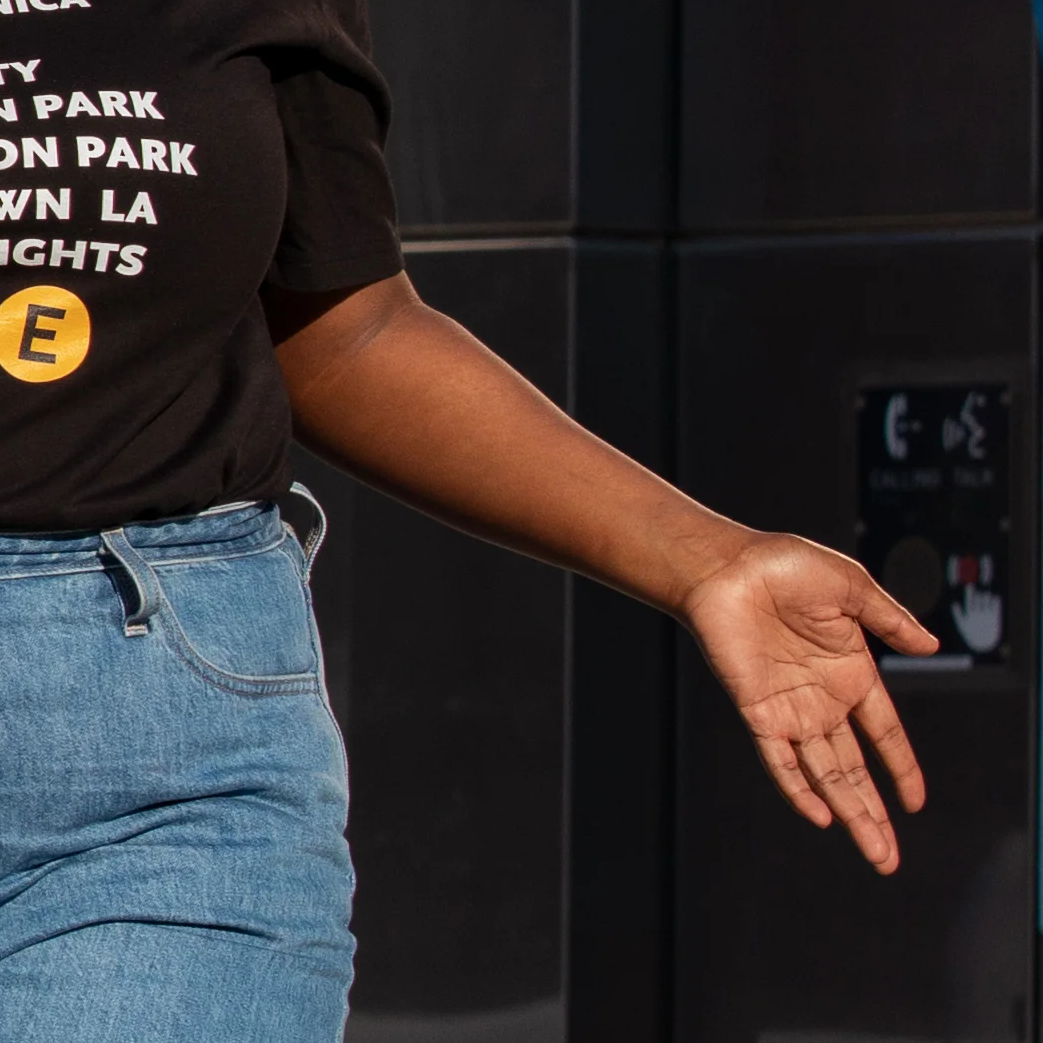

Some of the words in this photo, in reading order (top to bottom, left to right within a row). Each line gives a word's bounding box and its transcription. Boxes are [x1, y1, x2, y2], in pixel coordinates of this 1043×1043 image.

[33, 90, 165, 120] PARK
[76, 136, 198, 176] PARK
[101, 189, 157, 225] LA
[18, 304, 66, 364] E
